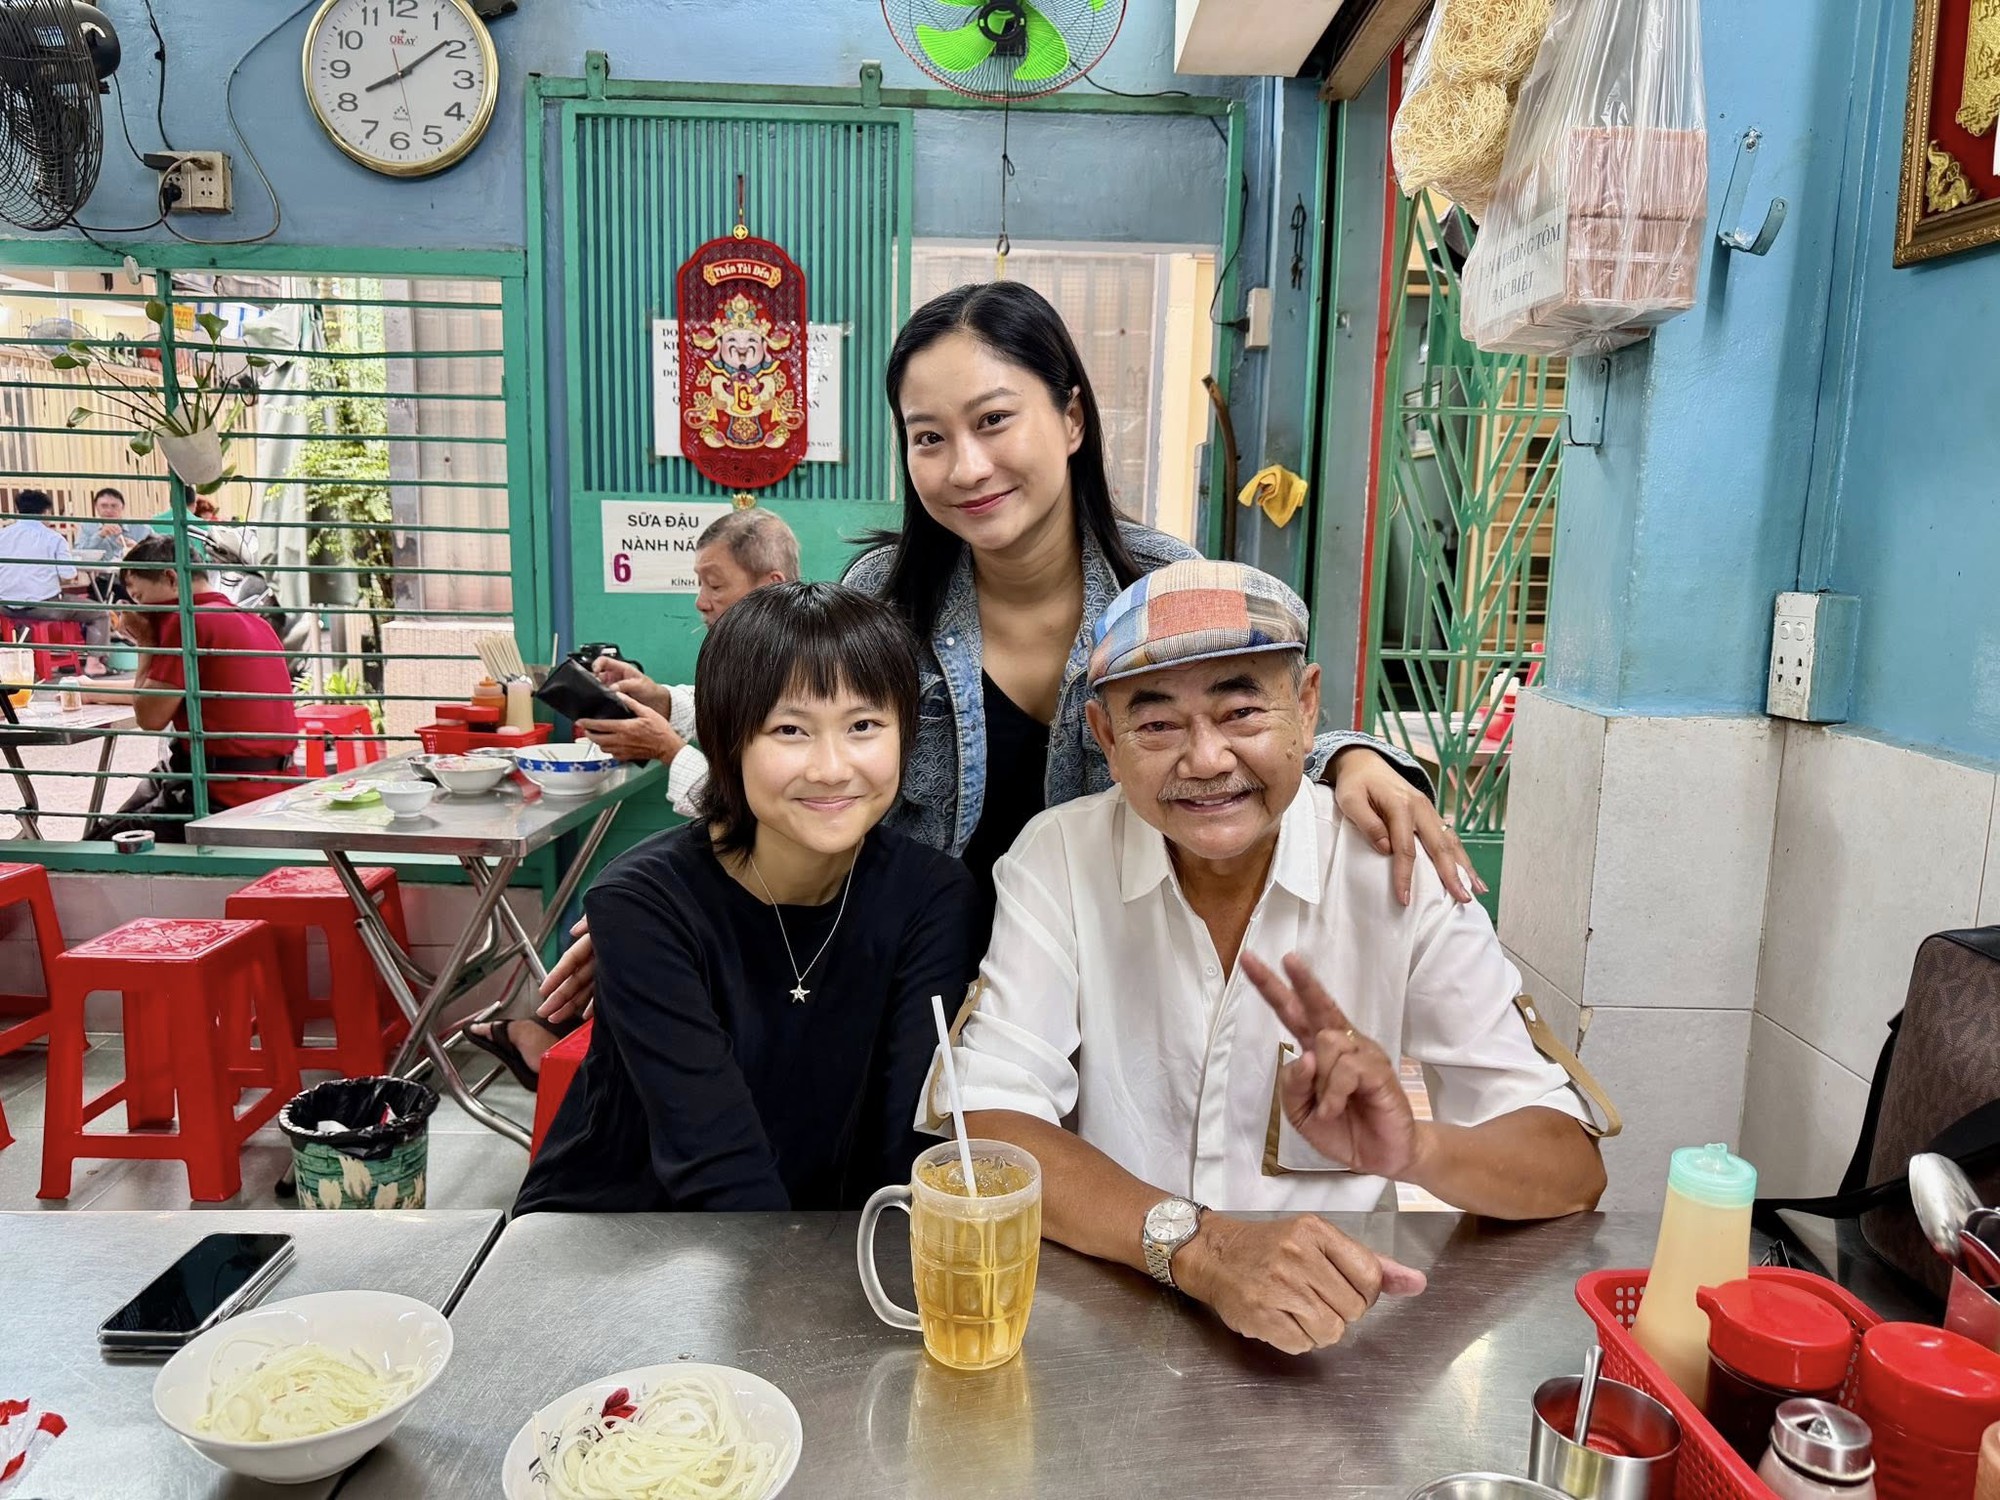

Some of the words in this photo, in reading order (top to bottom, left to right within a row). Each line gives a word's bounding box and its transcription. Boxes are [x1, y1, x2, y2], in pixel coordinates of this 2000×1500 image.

[361, 6, 379, 26] 11
[388, 0, 418, 19] 12
[432, 11, 439, 31] 1
[337, 29, 363, 50] 10
[445, 40, 467, 59] 2
[330, 60, 351, 79] 9
[453, 70, 475, 90] 3
[337, 92, 358, 112] 8
[444, 102, 465, 121] 4
[361, 119, 379, 140] 7
[422, 125, 443, 145] 5
[389, 131, 411, 150] 6
[1535, 223, 1561, 251] TÔM
[628, 512, 662, 527] SỮA
[665, 512, 699, 531] ĐẬU
[621, 535, 669, 552] NÀNH
[674, 535, 697, 552] NẤ
[613, 553, 632, 583] 6
